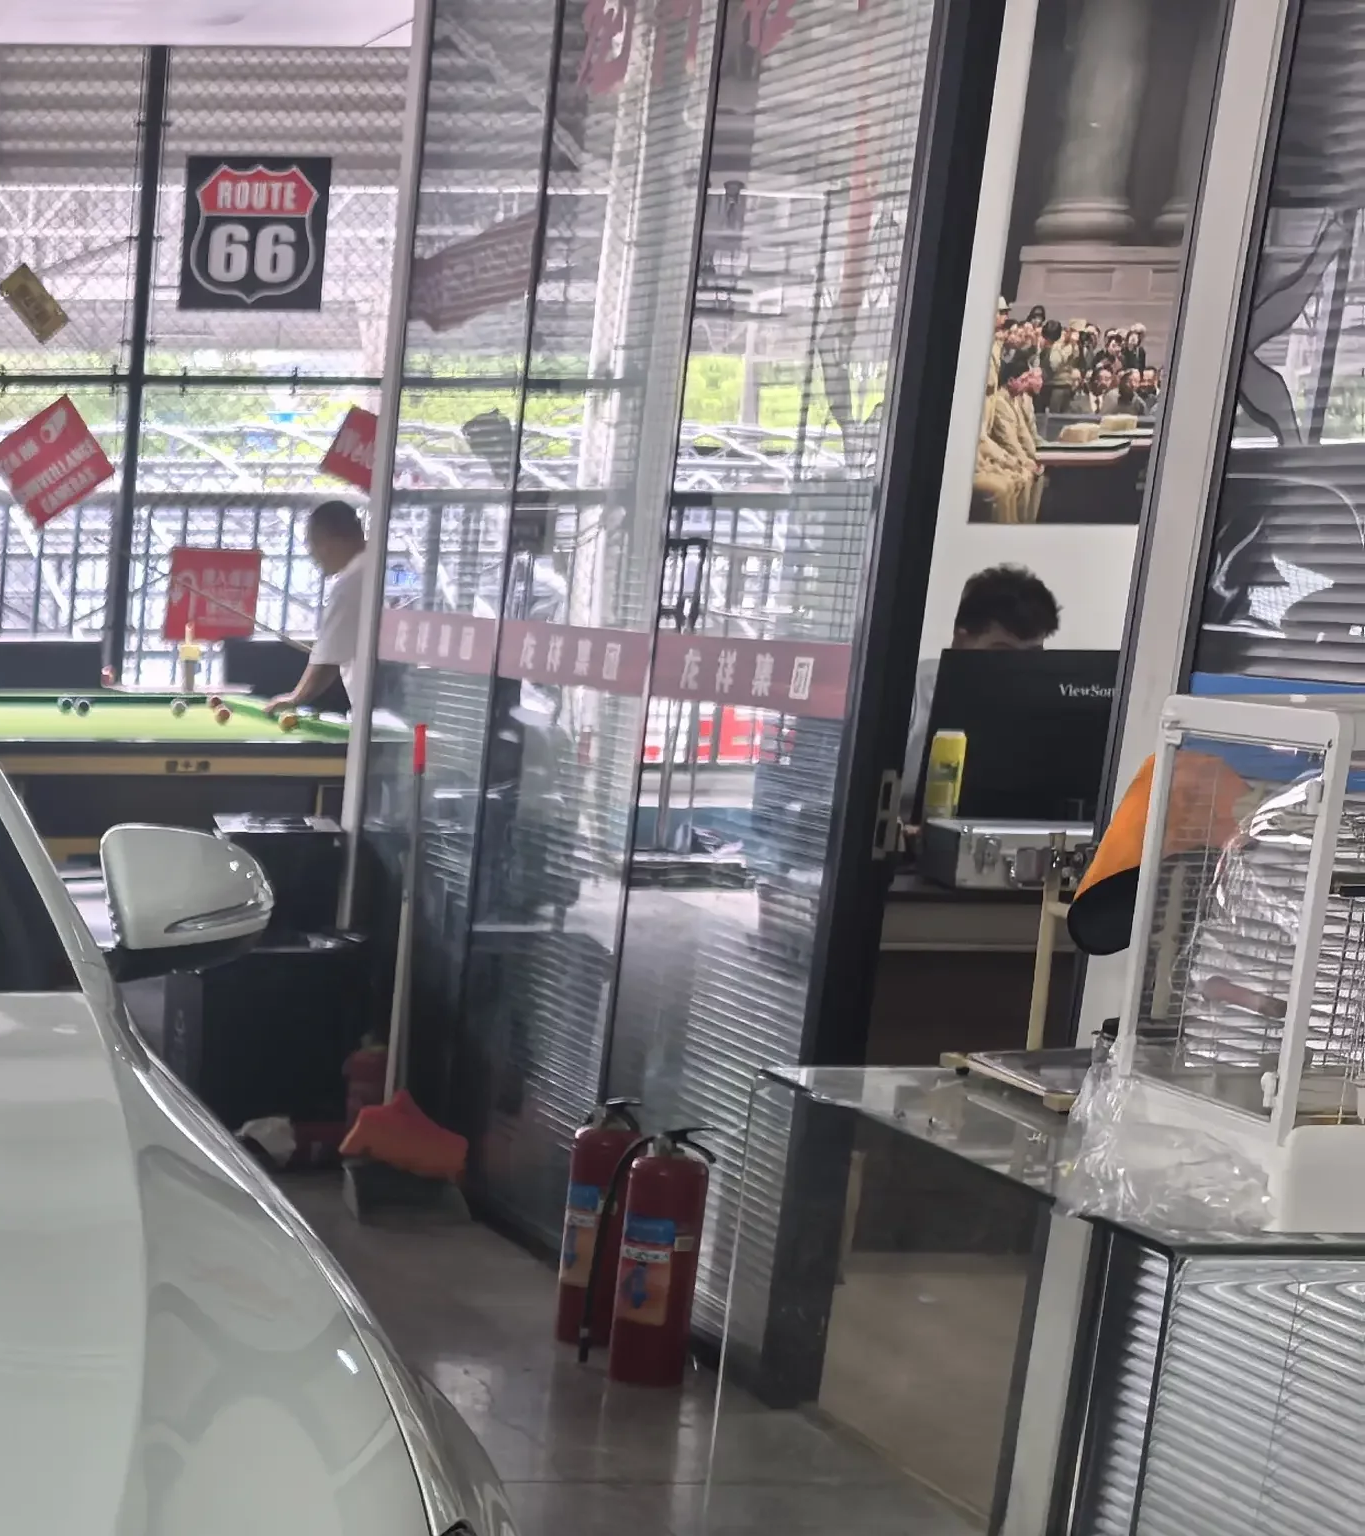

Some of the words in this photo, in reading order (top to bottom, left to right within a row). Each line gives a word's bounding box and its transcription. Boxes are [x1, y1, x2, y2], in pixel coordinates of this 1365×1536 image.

[216, 179, 297, 210] ROUTE
[207, 223, 296, 283] 66
[679, 648, 815, 700] 龙祥集团
[1058, 682, 1117, 697] ViewSon
